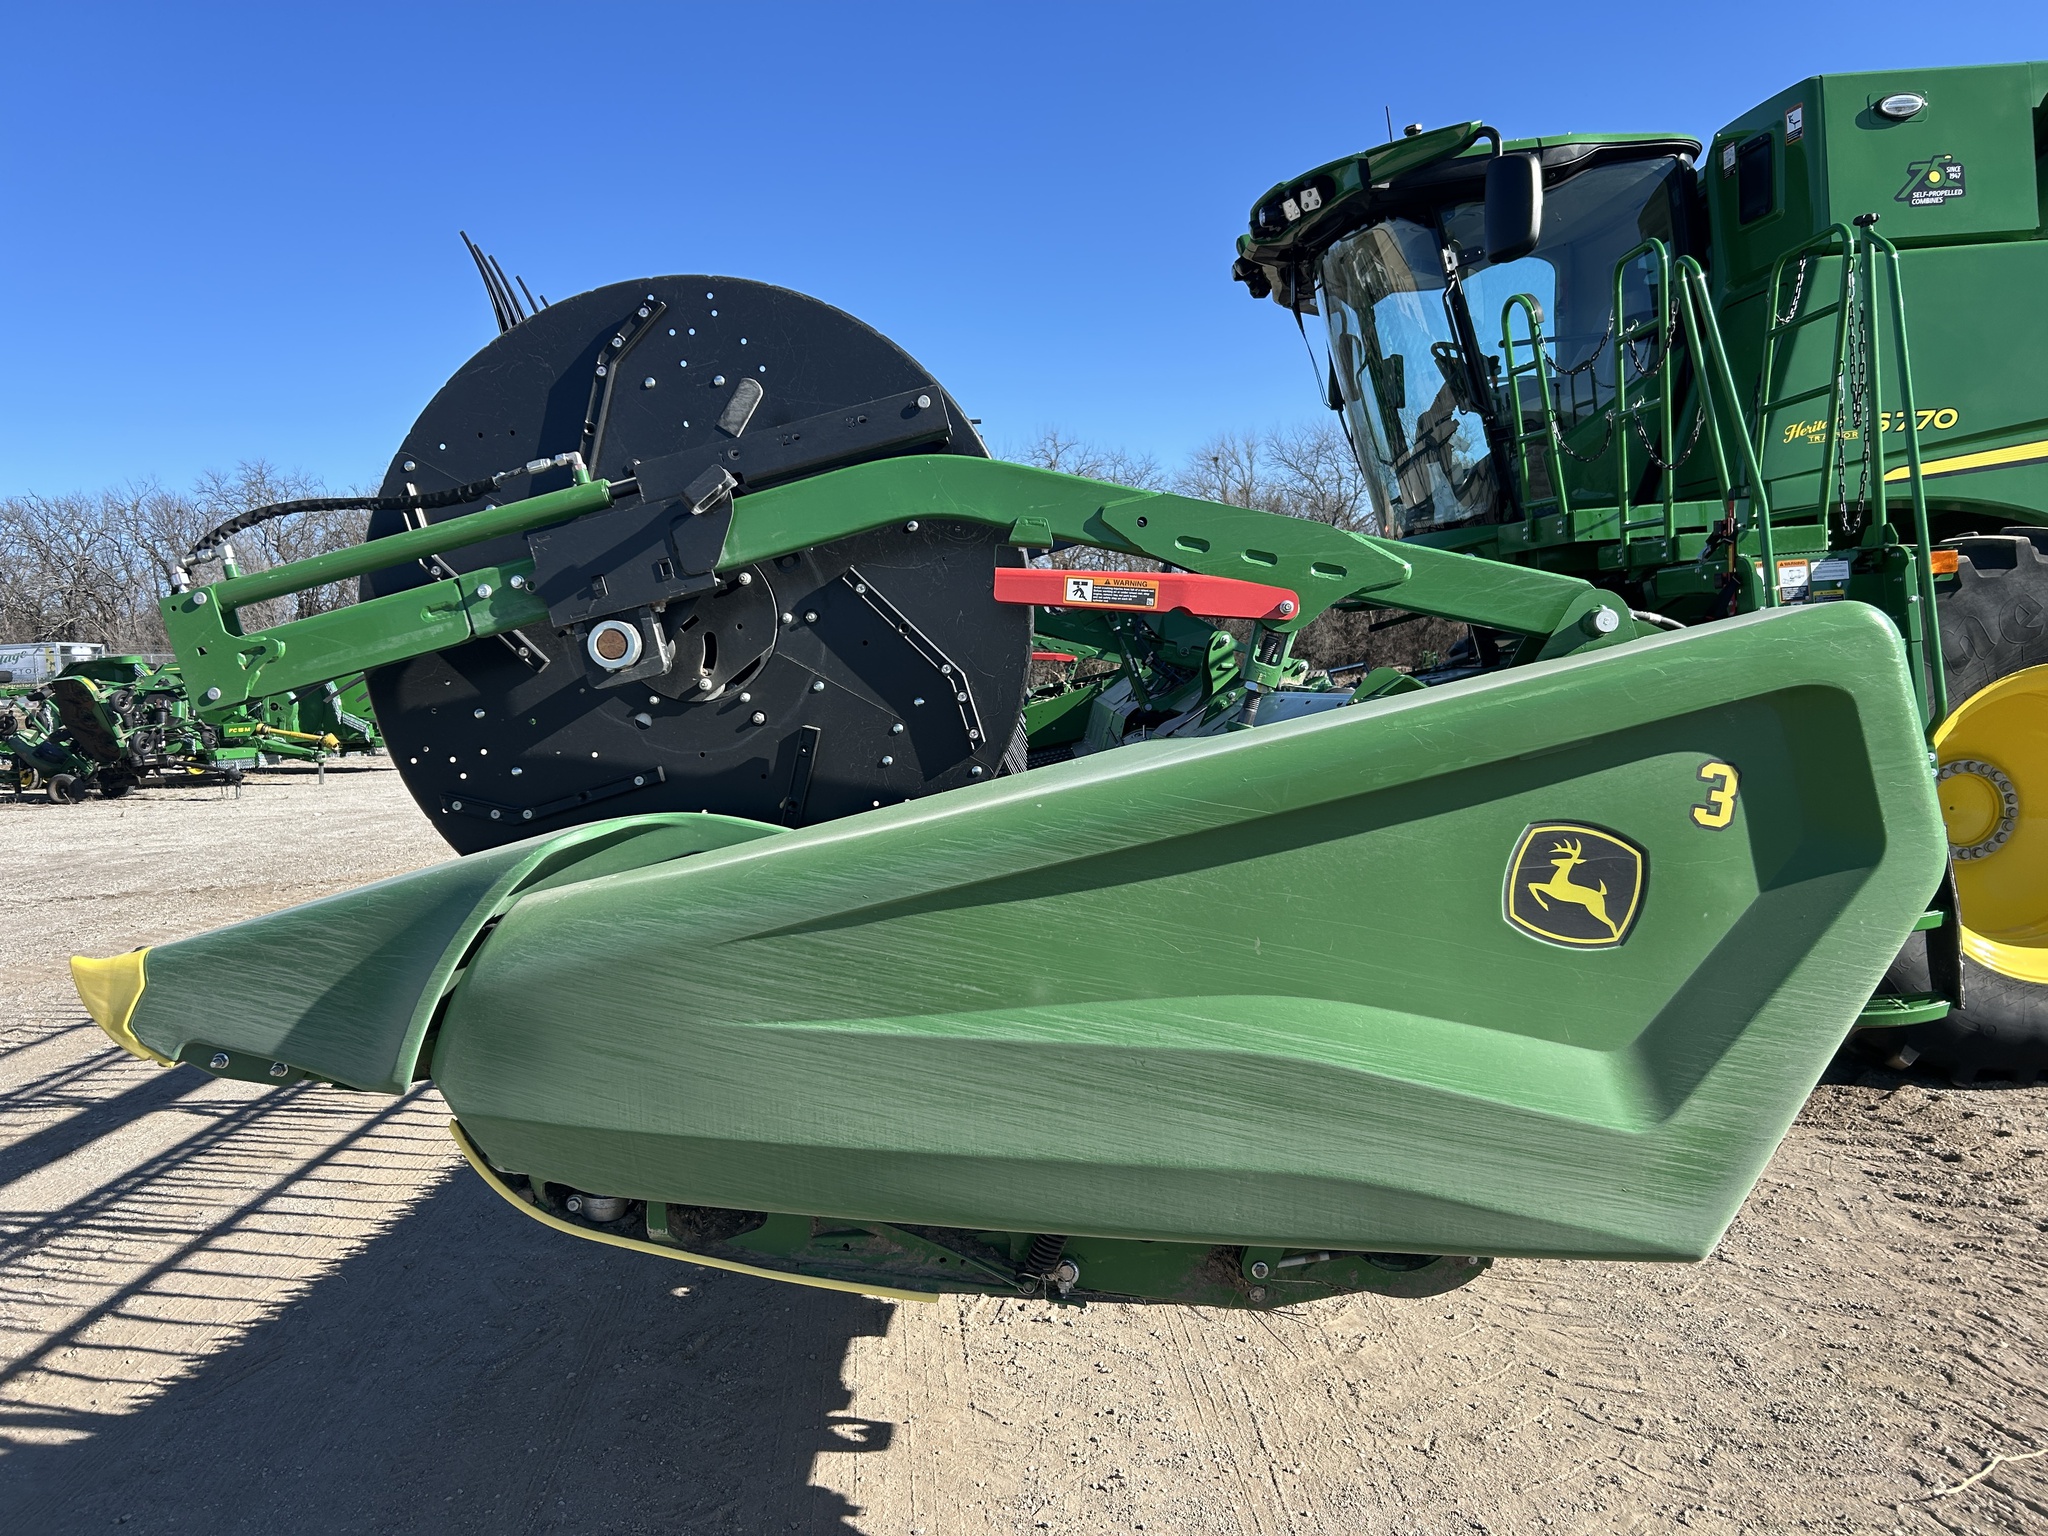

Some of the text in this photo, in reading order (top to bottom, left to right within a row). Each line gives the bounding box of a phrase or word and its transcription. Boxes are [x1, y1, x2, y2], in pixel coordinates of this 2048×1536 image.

[1912, 189, 1963, 198] SELF-PROPELLED
[1911, 197, 1944, 205] COMBINES
[1783, 416, 1847, 443] Herita
[1113, 579, 1148, 587] WARNING
[1691, 761, 1740, 830] 3
